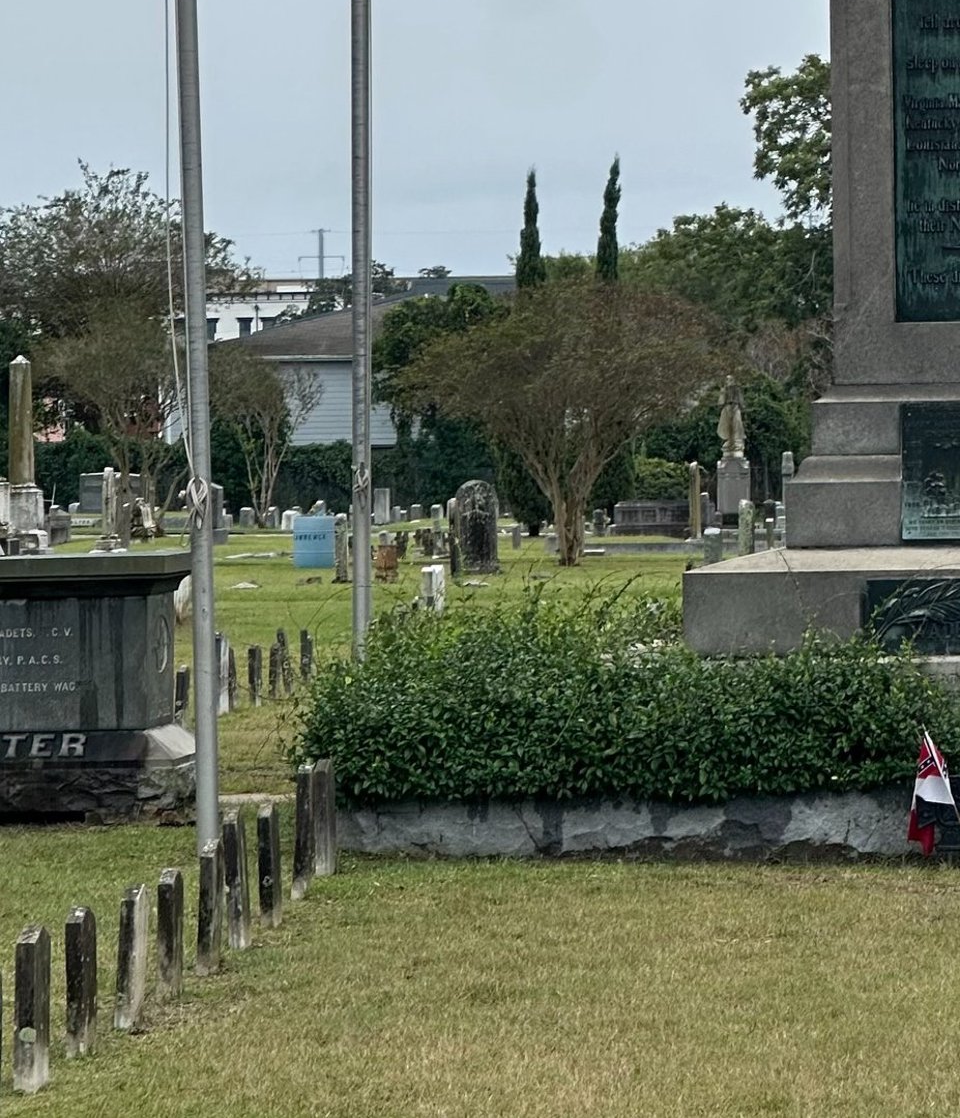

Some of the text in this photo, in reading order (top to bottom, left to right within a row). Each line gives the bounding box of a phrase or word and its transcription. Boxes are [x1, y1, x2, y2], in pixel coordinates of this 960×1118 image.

[906, 54, 938, 73] sleep
[941, 58, 955, 69] on
[919, 219, 944, 232] their
[911, 269, 946, 284] These
[0, 682, 48, 693] BATTERY
[2, 732, 87, 759] TER
